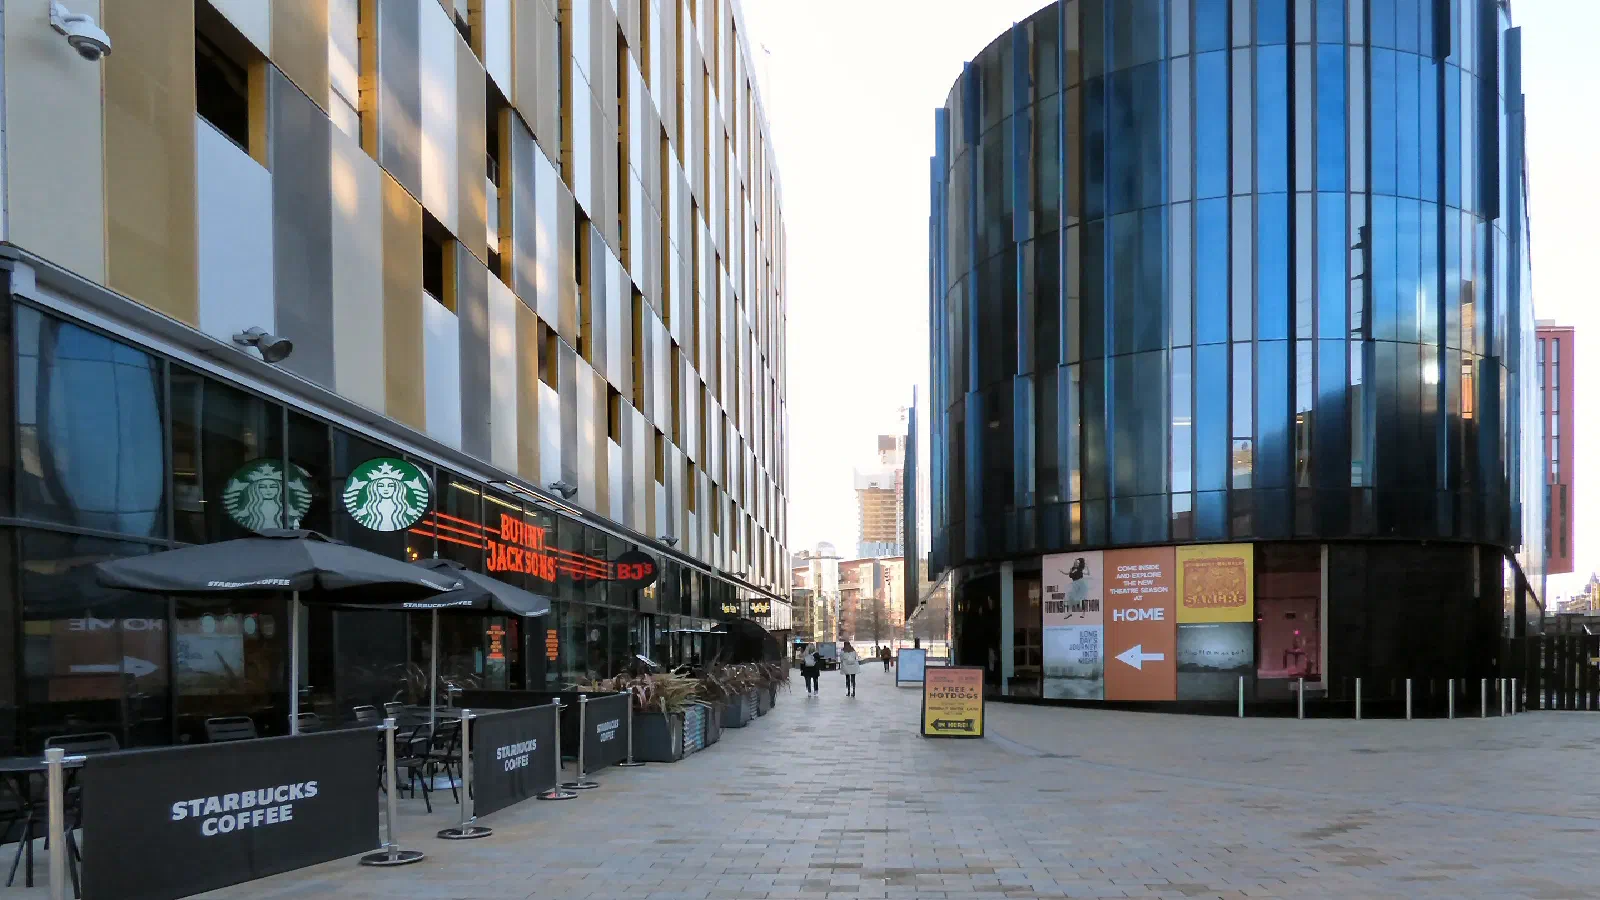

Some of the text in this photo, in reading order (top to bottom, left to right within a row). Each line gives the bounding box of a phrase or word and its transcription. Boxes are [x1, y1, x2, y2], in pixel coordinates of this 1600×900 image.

[1110, 587, 1139, 595] THEATRE
[1113, 607, 1164, 621] HOME
[1079, 630, 1098, 638] LONG
[496, 739, 537, 760] STARBUCKS
[171, 780, 319, 821] STARBUCKS
[201, 803, 293, 837] COFFEE
